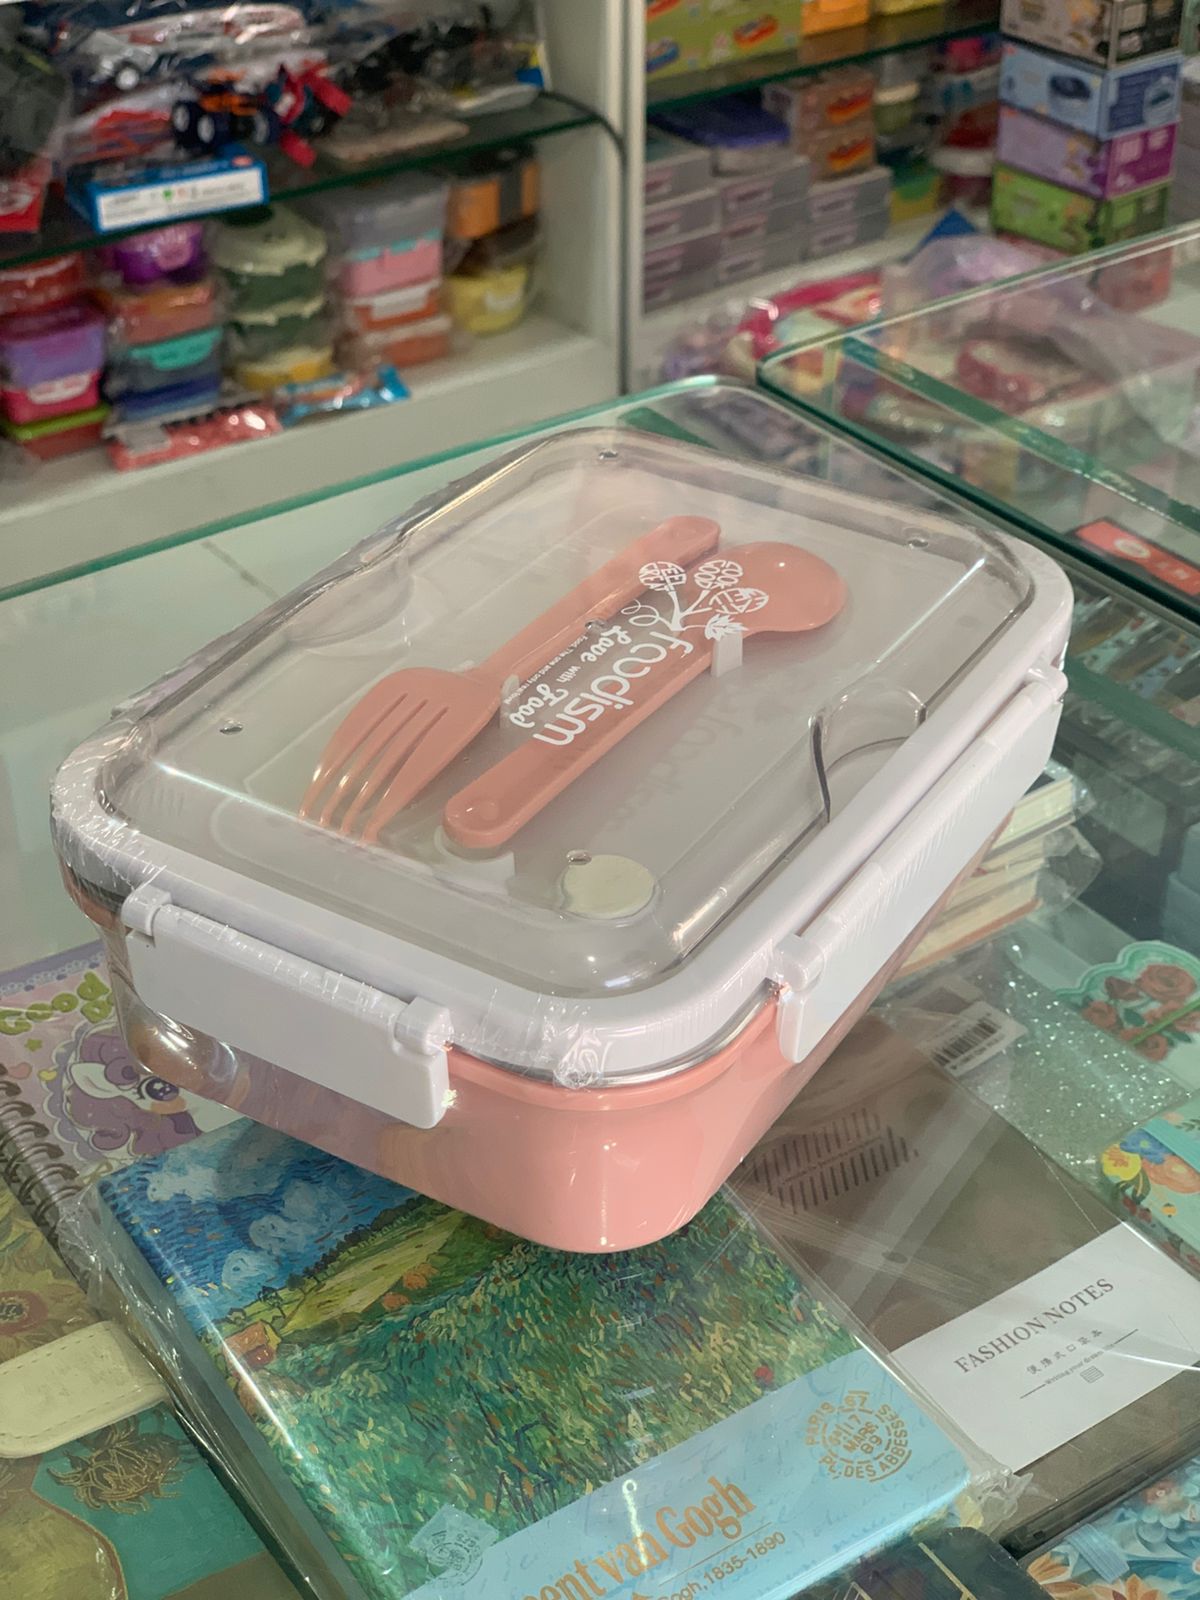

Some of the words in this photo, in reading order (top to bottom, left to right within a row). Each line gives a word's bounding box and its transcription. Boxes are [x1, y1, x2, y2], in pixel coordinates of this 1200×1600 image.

[580, 625, 632, 662] Love
[556, 665, 581, 683] with
[509, 683, 570, 728] Food
[953, 1316, 1047, 1374] FASHION
[1042, 1277, 1115, 1325] NOTES
[843, 1464, 877, 1479] DES
[879, 1403, 908, 1473] ABBESSES
[592, 1530, 670, 1584] van
[655, 1475, 758, 1549] Gogh
